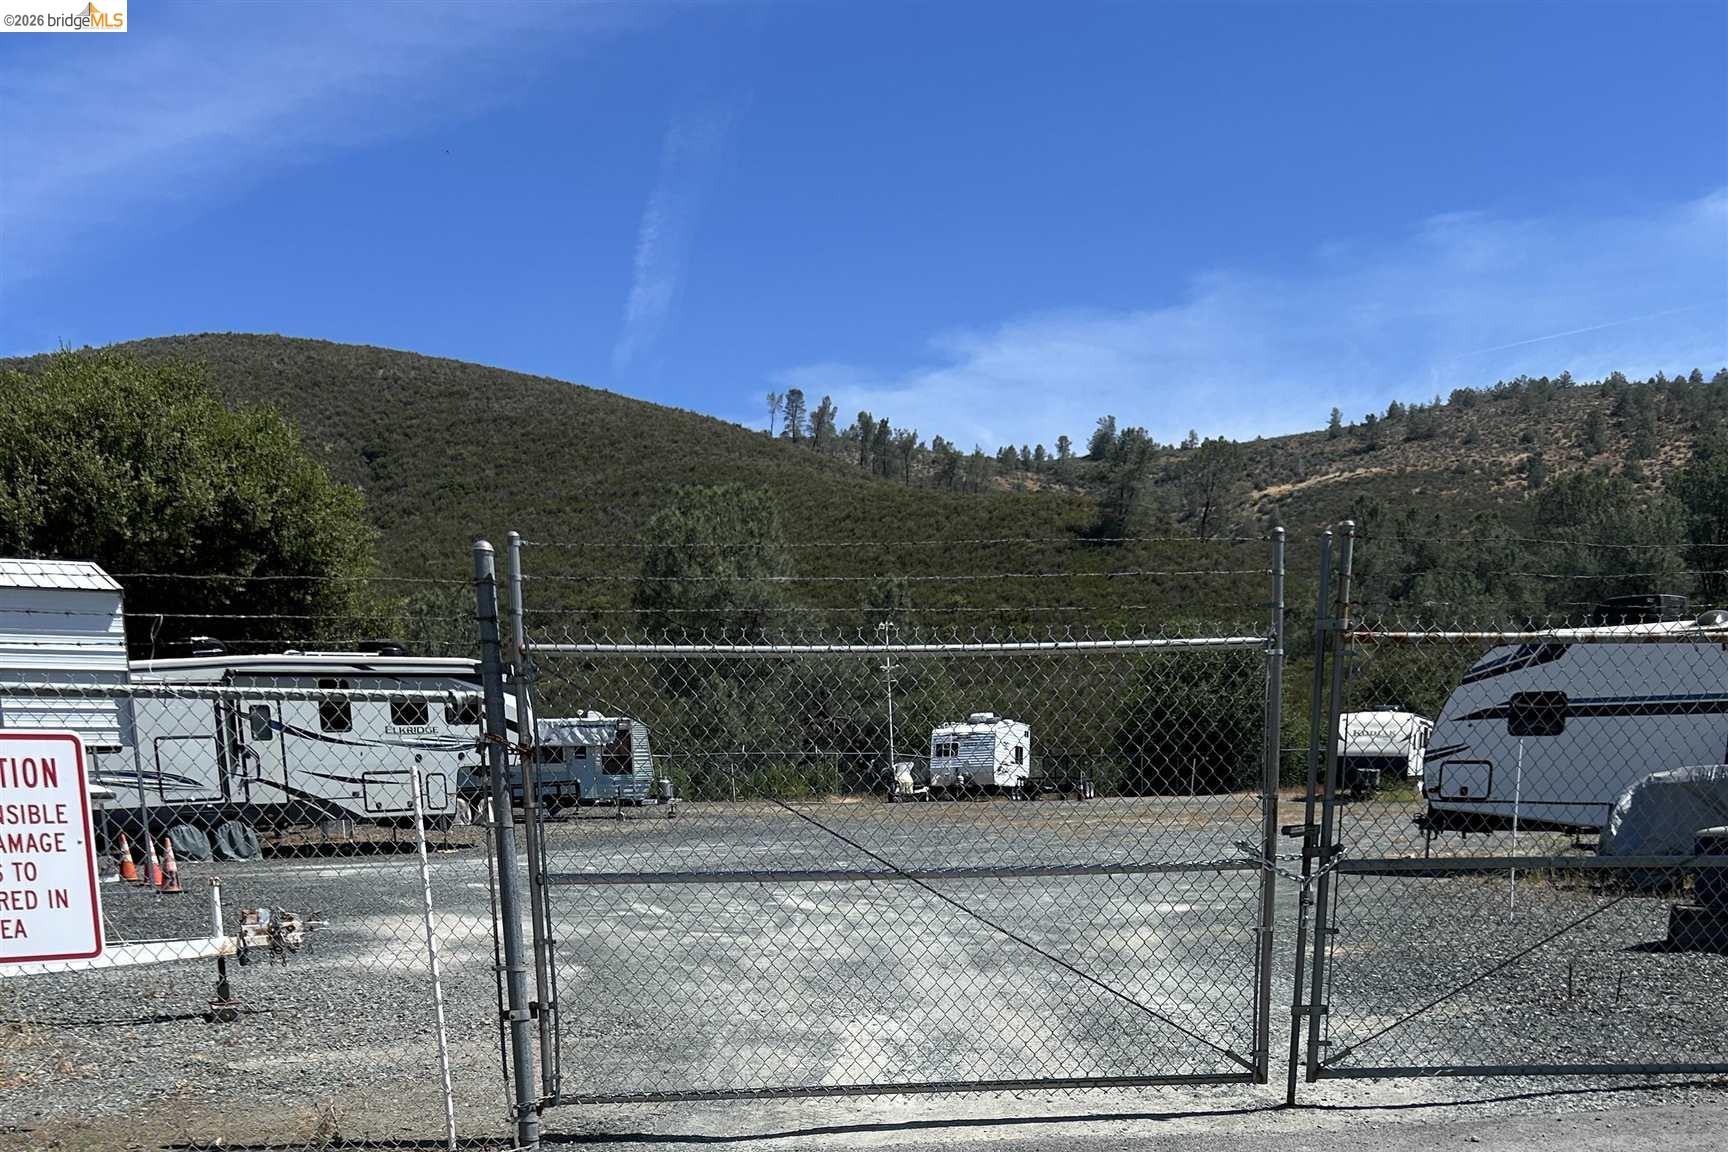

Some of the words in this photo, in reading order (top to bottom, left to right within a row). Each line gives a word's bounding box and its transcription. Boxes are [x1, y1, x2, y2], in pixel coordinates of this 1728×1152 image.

[385, 726, 439, 735] ELKRIDGE
[0, 758, 58, 788] TION
[0, 804, 68, 824] SIBLE
[11, 862, 37, 881] TO
[48, 889, 69, 909] IN
